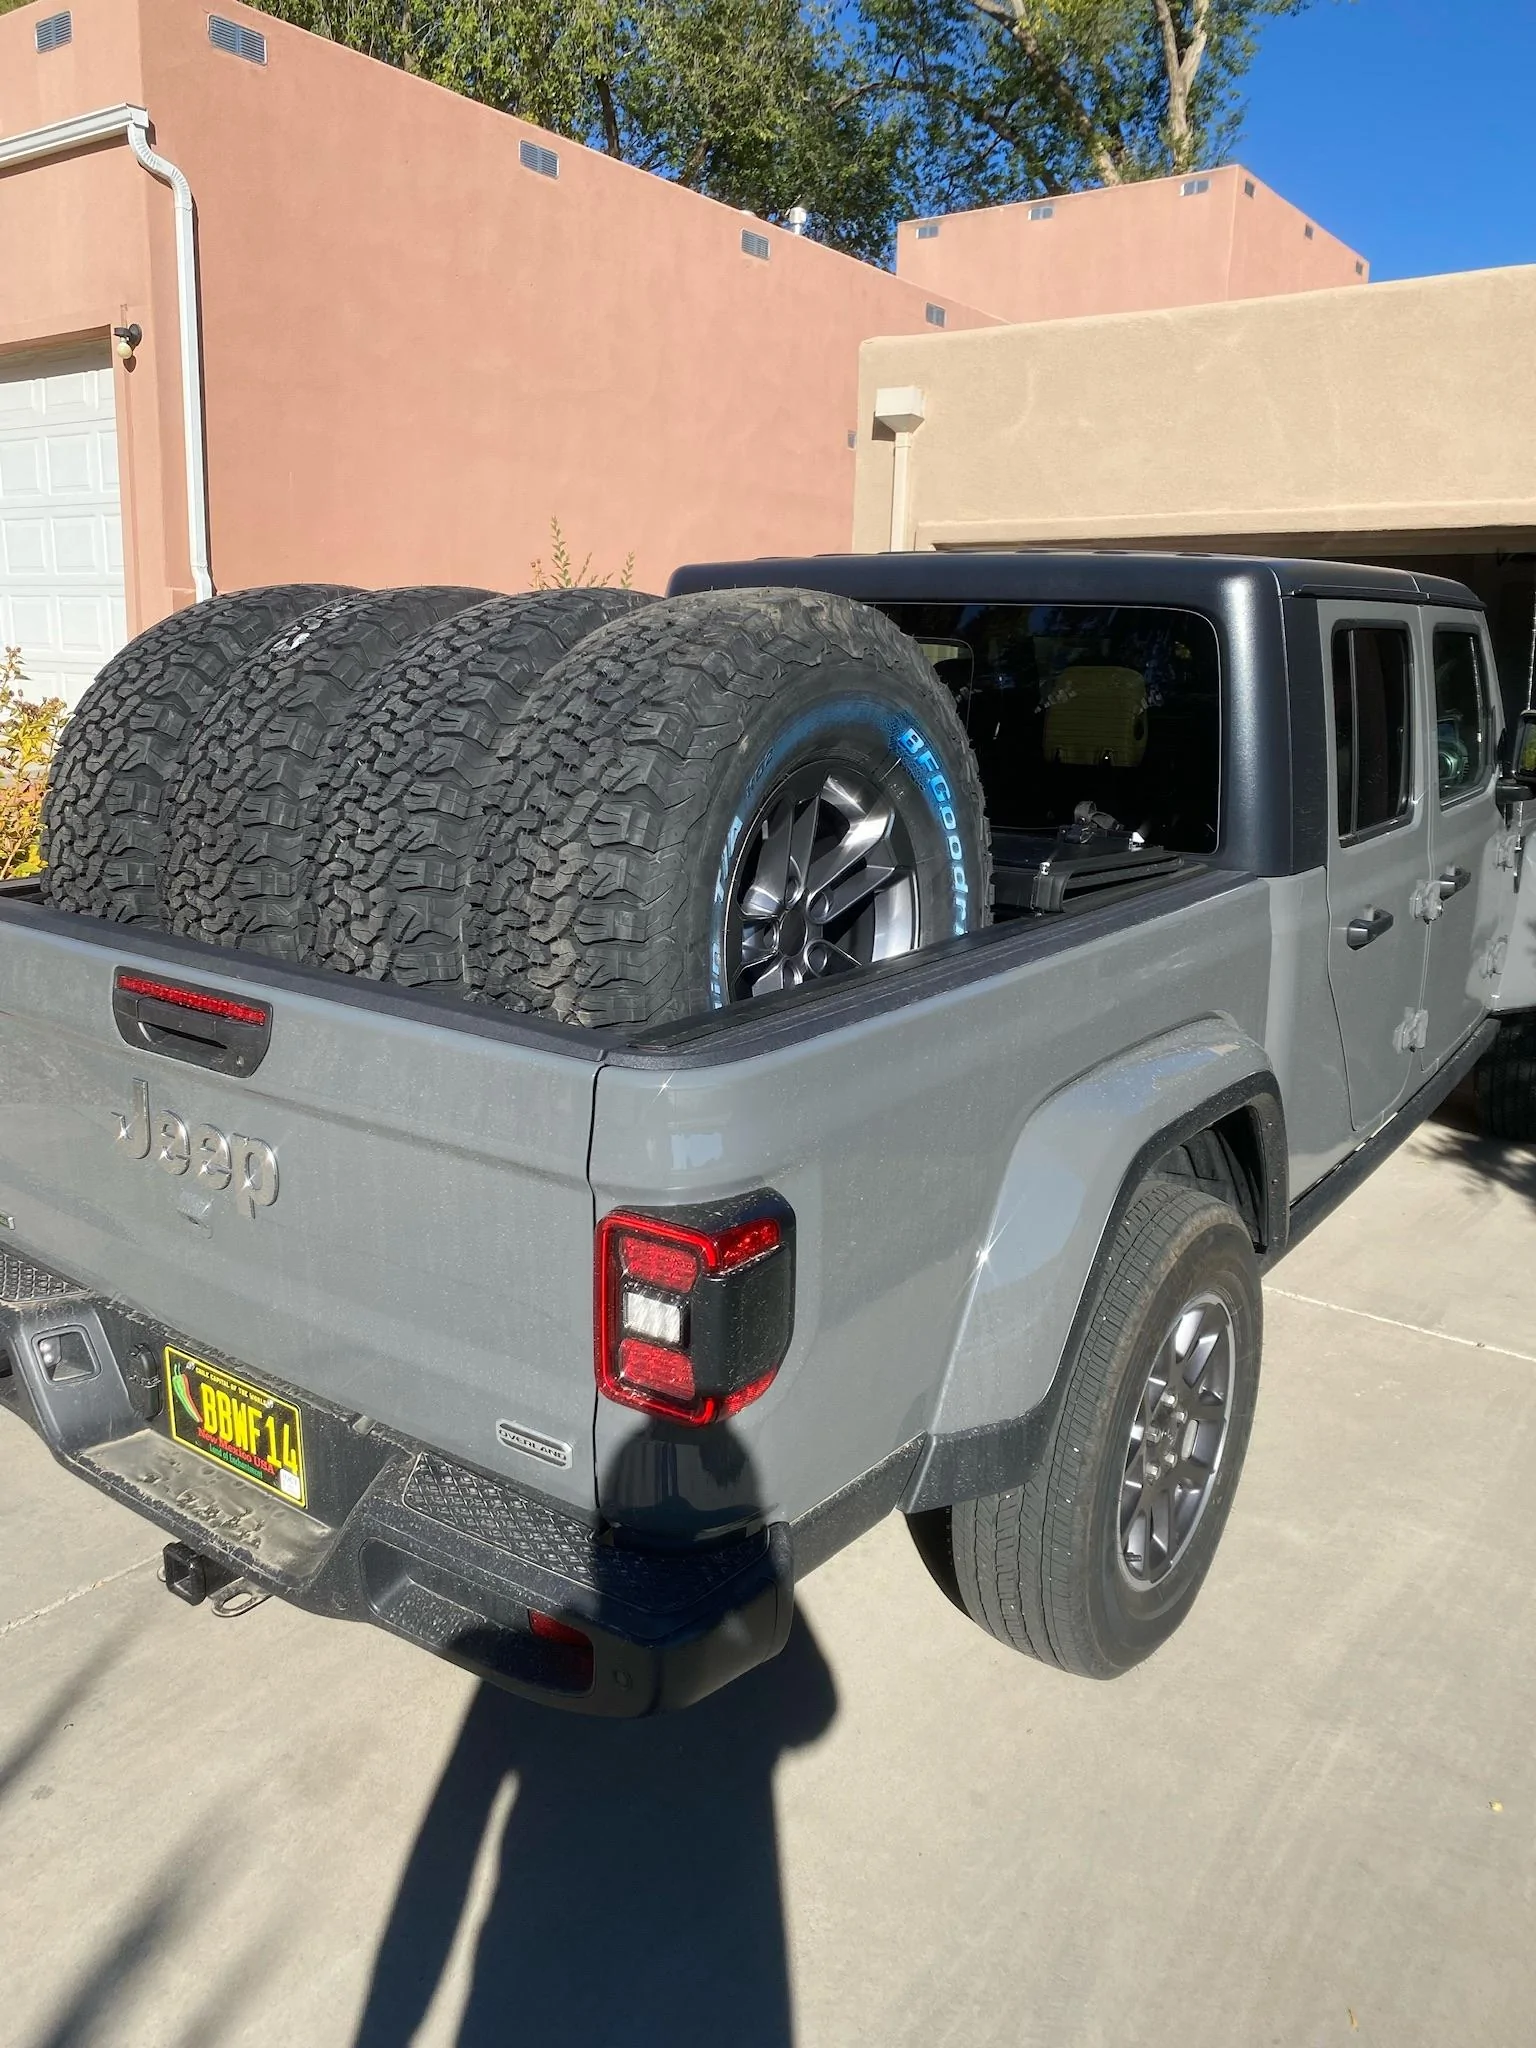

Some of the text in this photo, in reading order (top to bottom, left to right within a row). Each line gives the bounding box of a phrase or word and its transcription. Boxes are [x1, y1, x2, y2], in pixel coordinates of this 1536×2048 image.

[111, 1077, 280, 1219] Jeep
[210, 1373, 230, 1388] CAPITAL
[237, 1387, 249, 1398] THE
[197, 1427, 276, 1475] New Mexico USA
[209, 1443, 223, 1458] Land
[499, 1429, 567, 1461] OVERLAND
